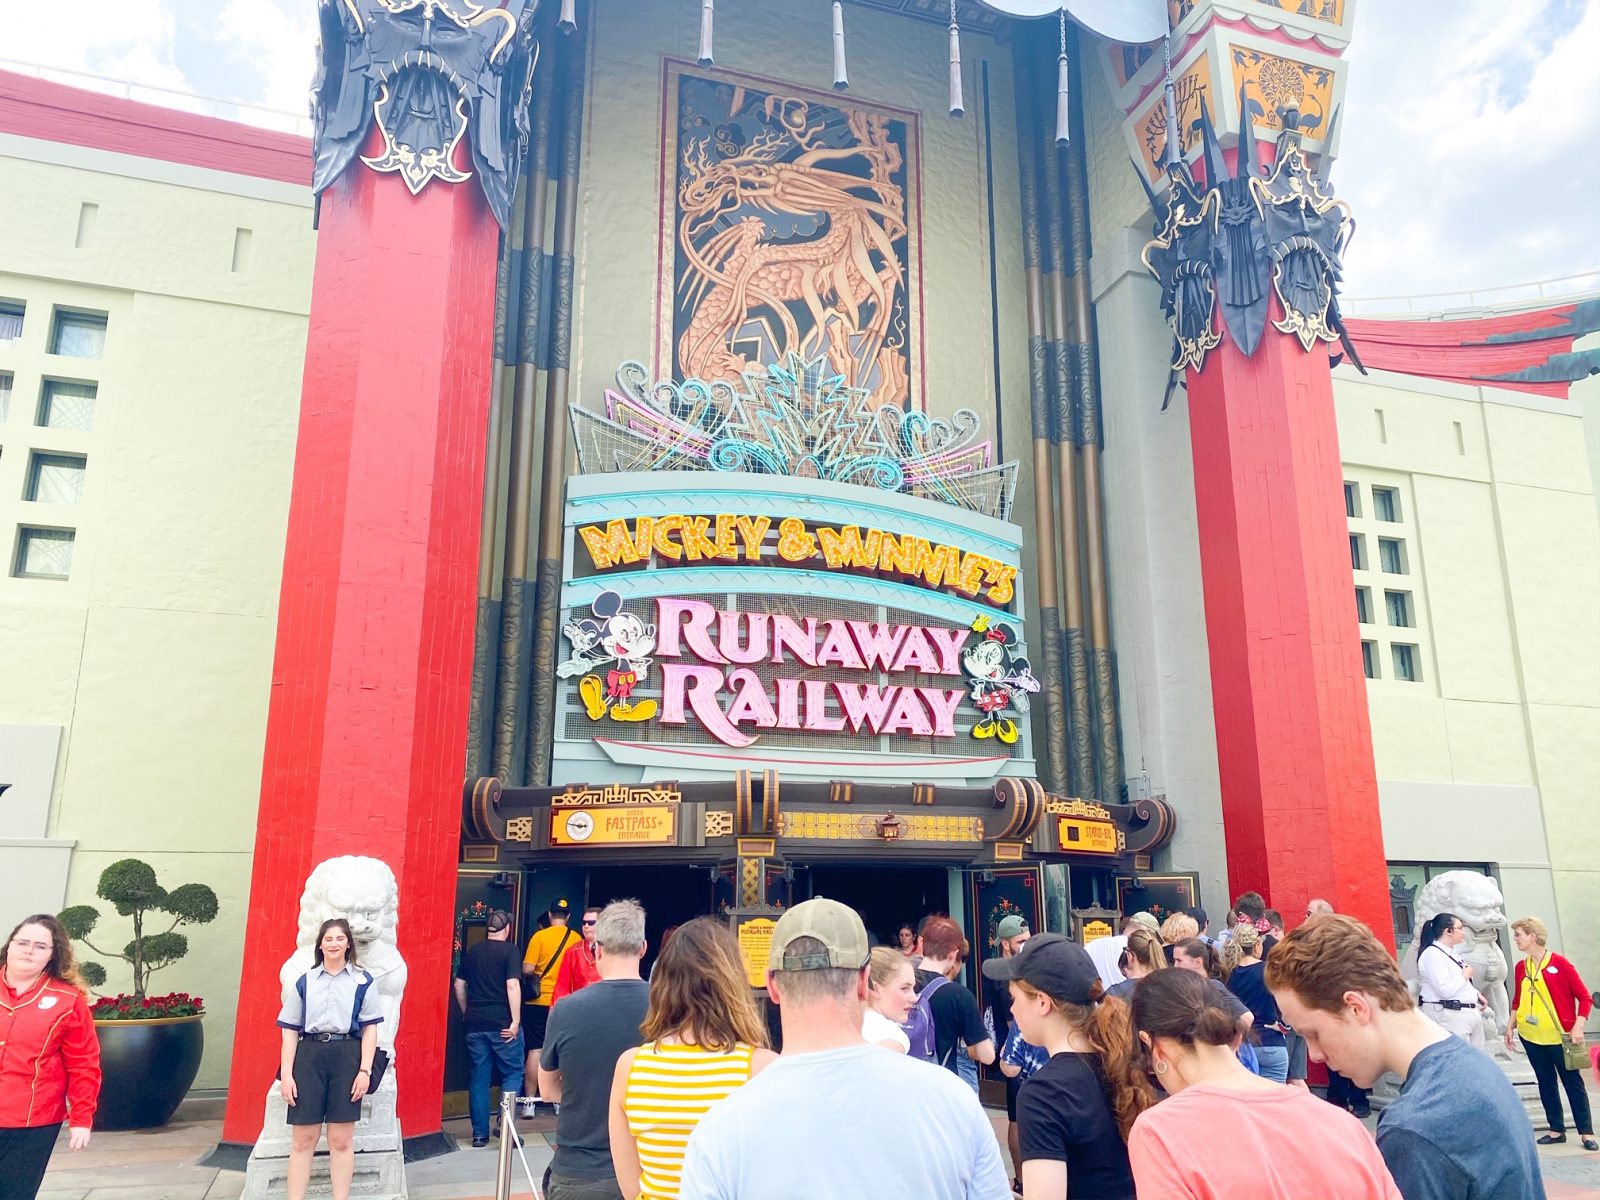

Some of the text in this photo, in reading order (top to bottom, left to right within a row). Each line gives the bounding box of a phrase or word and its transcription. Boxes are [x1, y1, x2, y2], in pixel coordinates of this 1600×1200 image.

[578, 514, 1017, 605] MICKEY & MINNIE'S
[655, 597, 970, 676] RUNAWAY
[660, 663, 966, 748] RAILWAY
